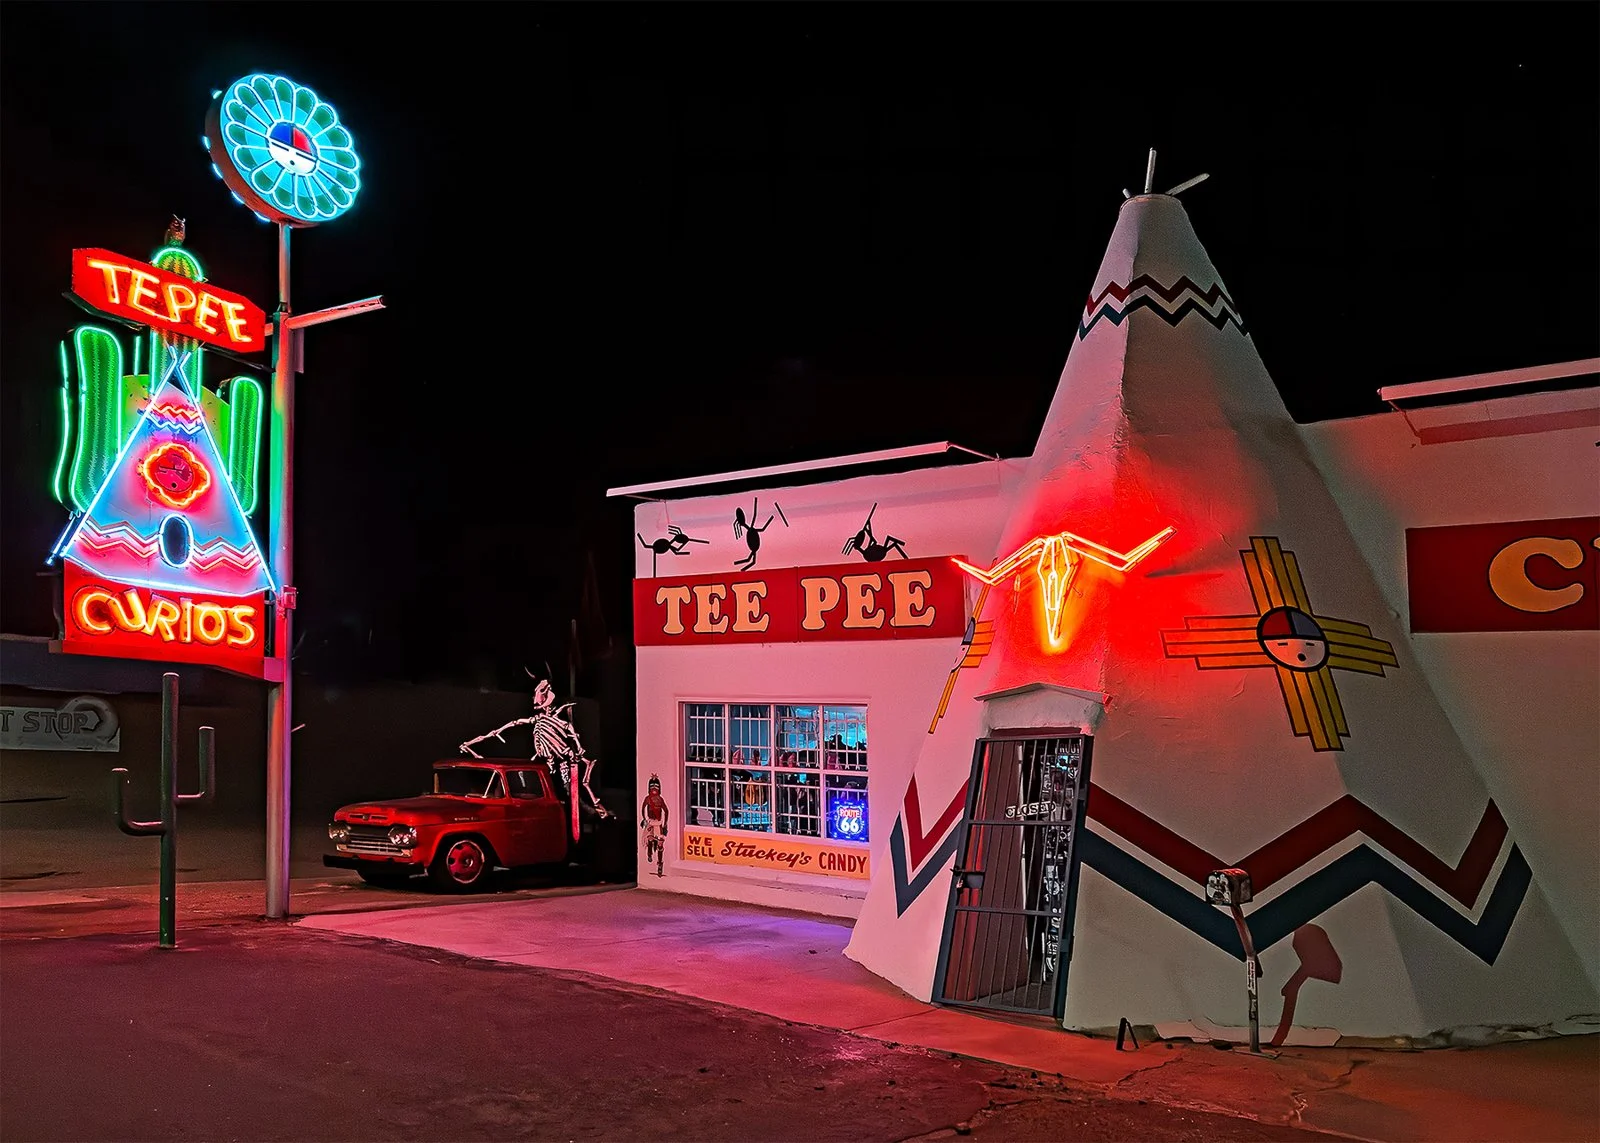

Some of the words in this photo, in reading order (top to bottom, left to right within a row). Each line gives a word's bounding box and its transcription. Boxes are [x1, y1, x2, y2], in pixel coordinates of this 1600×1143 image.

[87, 258, 252, 343] TEPEE
[1488, 536, 1600, 613] C
[655, 580, 770, 636] TEE
[800, 570, 936, 630] PEE
[74, 586, 256, 648] CURIOS
[22, 710, 89, 734] STOP
[840, 807, 860, 818] ROUTE
[1005, 800, 1057, 818] CLOSED
[840, 816, 859, 833] 66
[686, 845, 715, 858] SELL
[688, 835, 712, 846] WE
[720, 840, 813, 868] Stuckey's
[818, 851, 868, 873] CANDY
